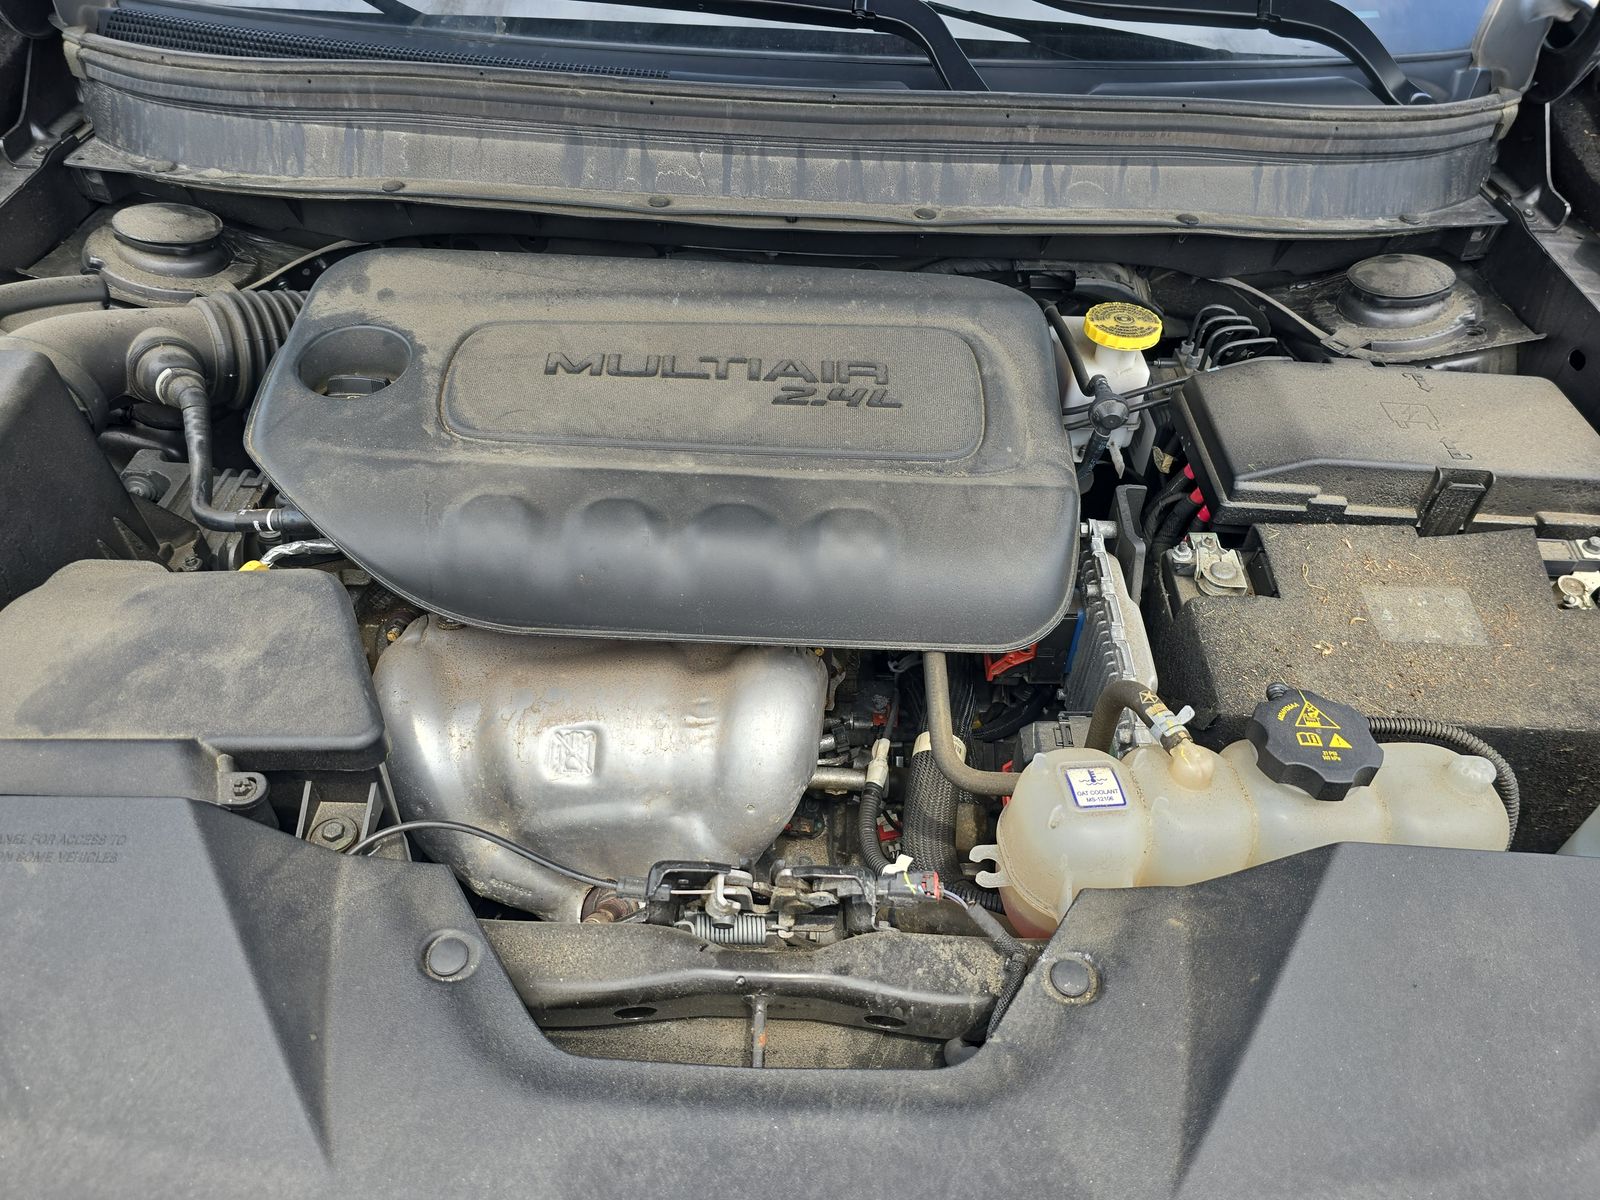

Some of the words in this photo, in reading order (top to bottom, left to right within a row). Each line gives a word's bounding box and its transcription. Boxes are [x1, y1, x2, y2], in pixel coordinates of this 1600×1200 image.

[544, 352, 889, 385] MULTIAIR
[772, 385, 902, 408] 2.4L
[1090, 788, 1118, 796] COOLANT
[31, 832, 56, 845] FOR
[59, 833, 107, 846] ACCESS
[110, 833, 127, 846] TO
[16, 851, 53, 863] SOME
[58, 851, 118, 863] VEHICLES
